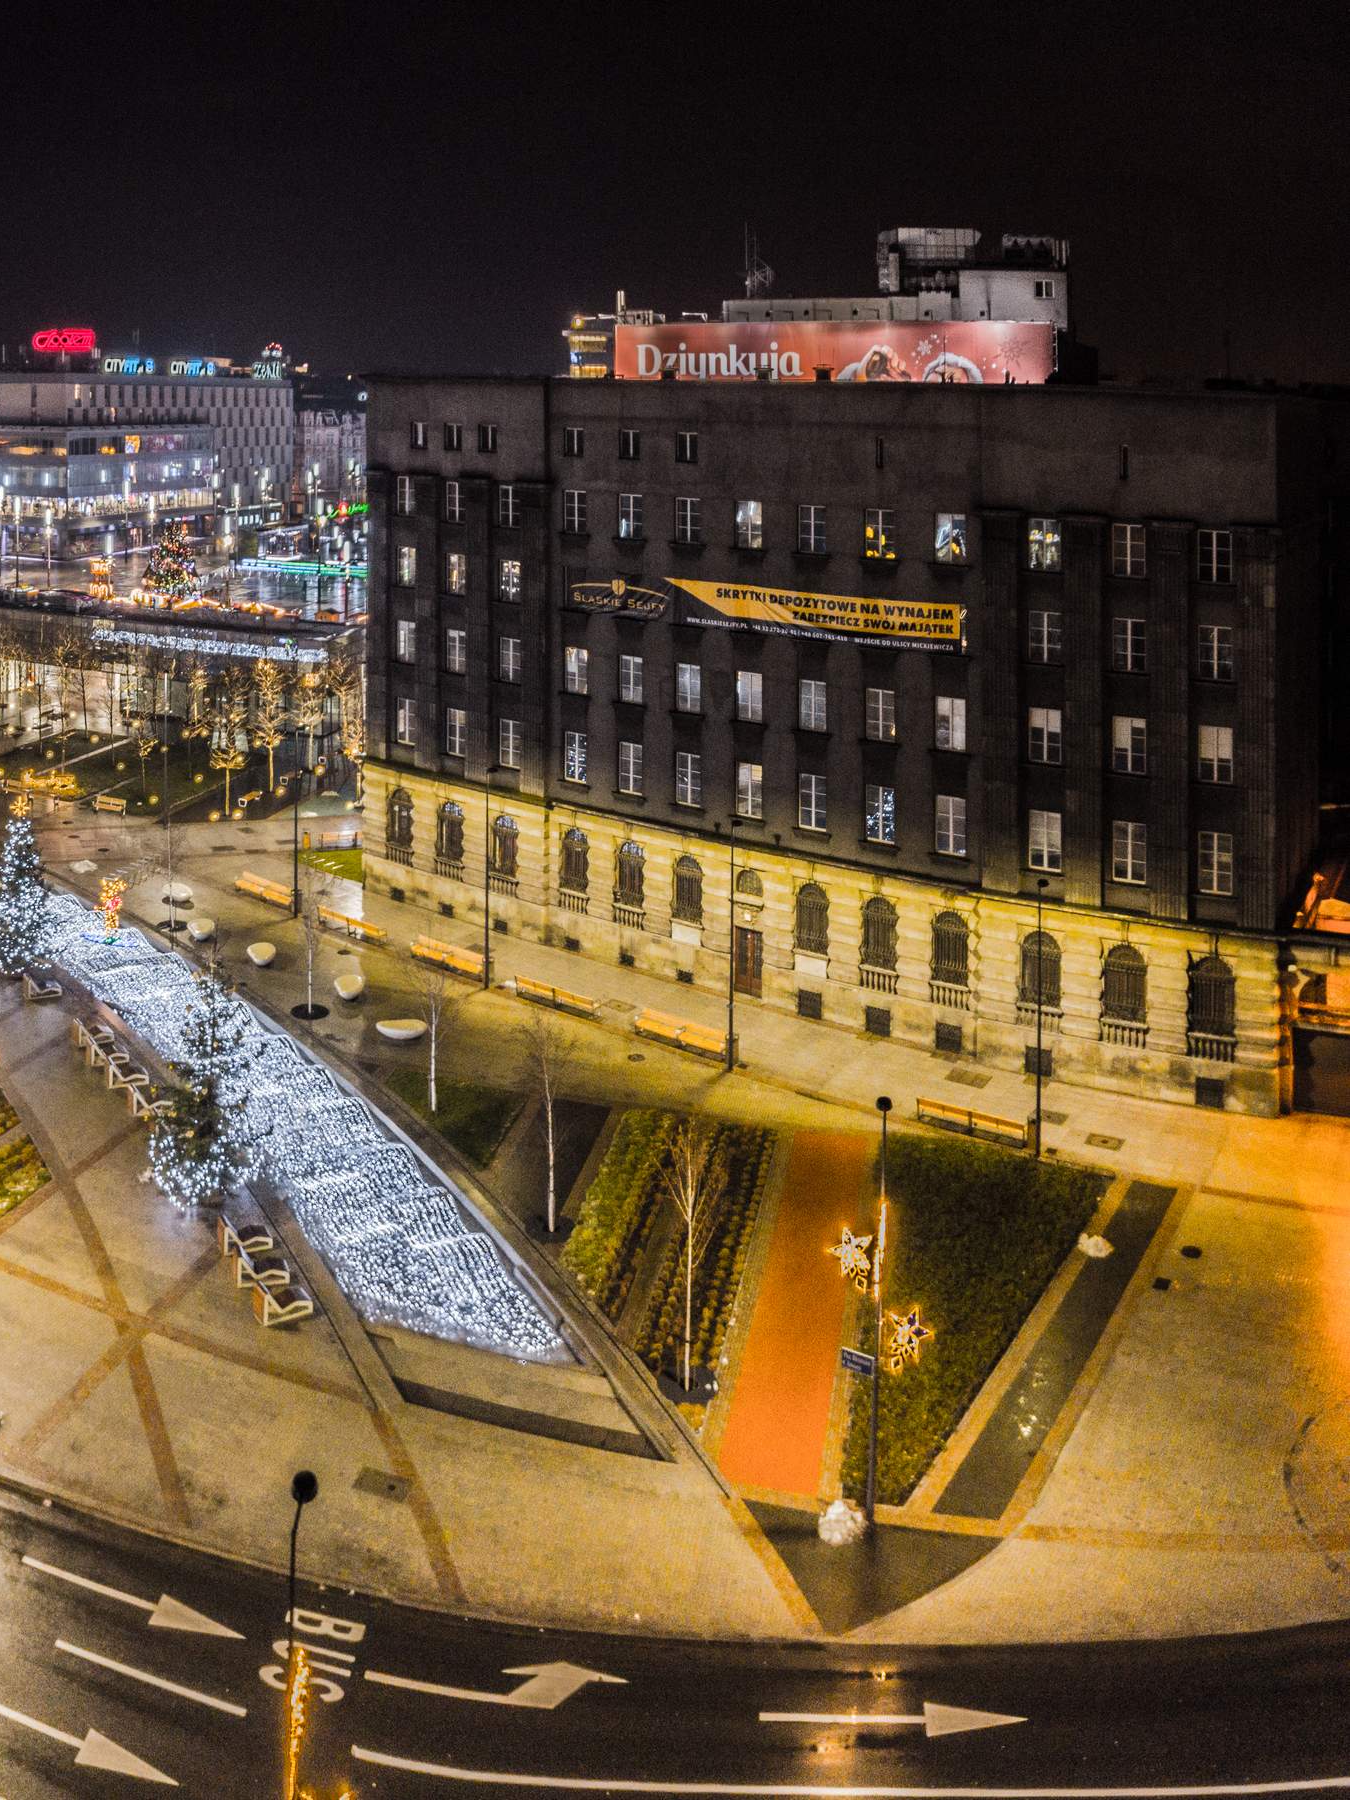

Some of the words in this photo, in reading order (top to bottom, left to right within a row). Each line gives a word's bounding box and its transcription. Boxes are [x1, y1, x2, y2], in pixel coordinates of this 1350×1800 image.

[716, 587, 766, 602] SKRYTKI
[769, 594, 857, 612] DEPOZYTOWE
[860, 603, 880, 615] NA
[883, 605, 954, 620] WYNAJEM
[792, 610, 860, 627] ZABEZPIECZ
[863, 615, 896, 630] SWÓJ
[898, 621, 954, 635] MAJĄTEK
[259, 1608, 366, 1702] BUS
